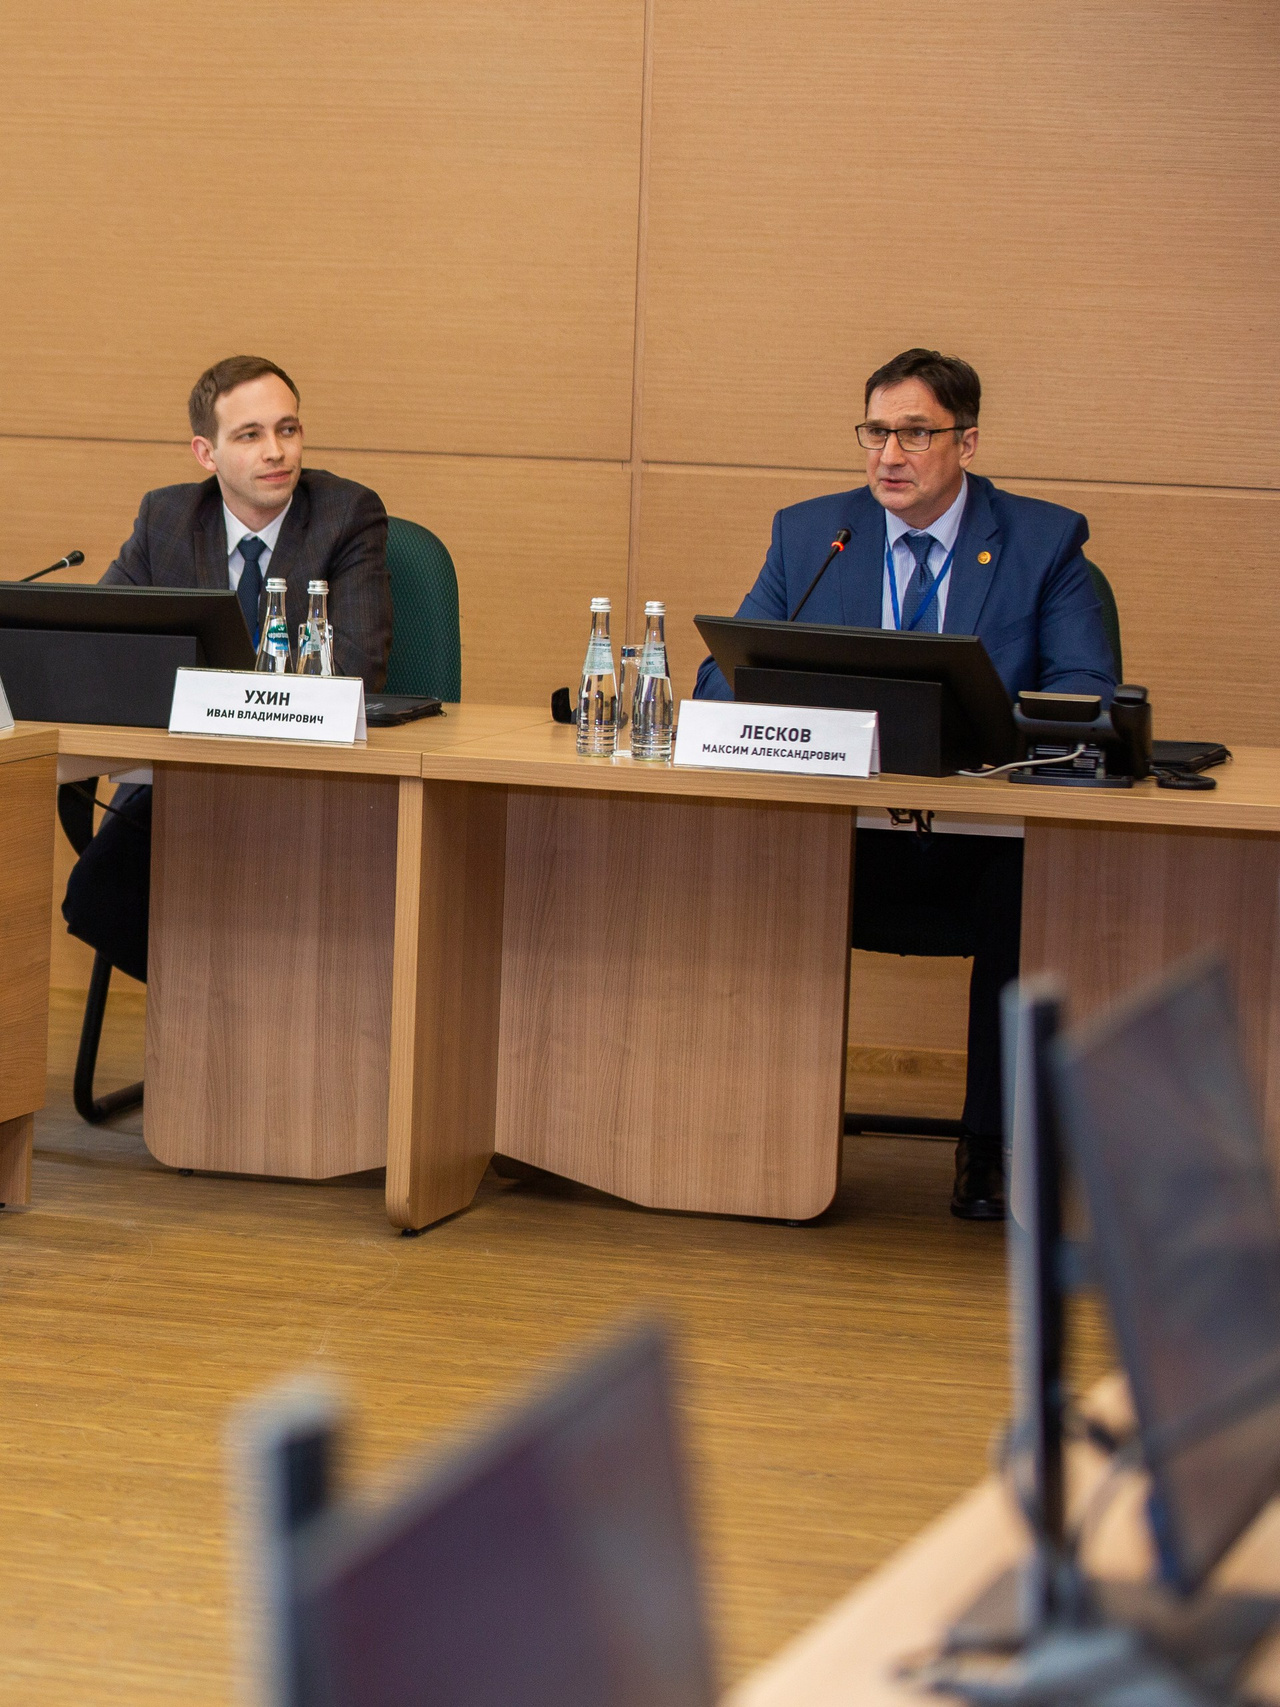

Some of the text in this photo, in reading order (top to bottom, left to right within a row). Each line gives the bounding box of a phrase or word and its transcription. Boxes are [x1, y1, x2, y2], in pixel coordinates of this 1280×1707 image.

[244, 689, 291, 706] УХИН
[206, 708, 324, 724] ИВАН ВЛАДИМИРОВИЧ
[740, 724, 812, 743] ЛЕСКОВ
[702, 743, 846, 761] МАКСИМ АЛЕКСАНДРОВИЧ
